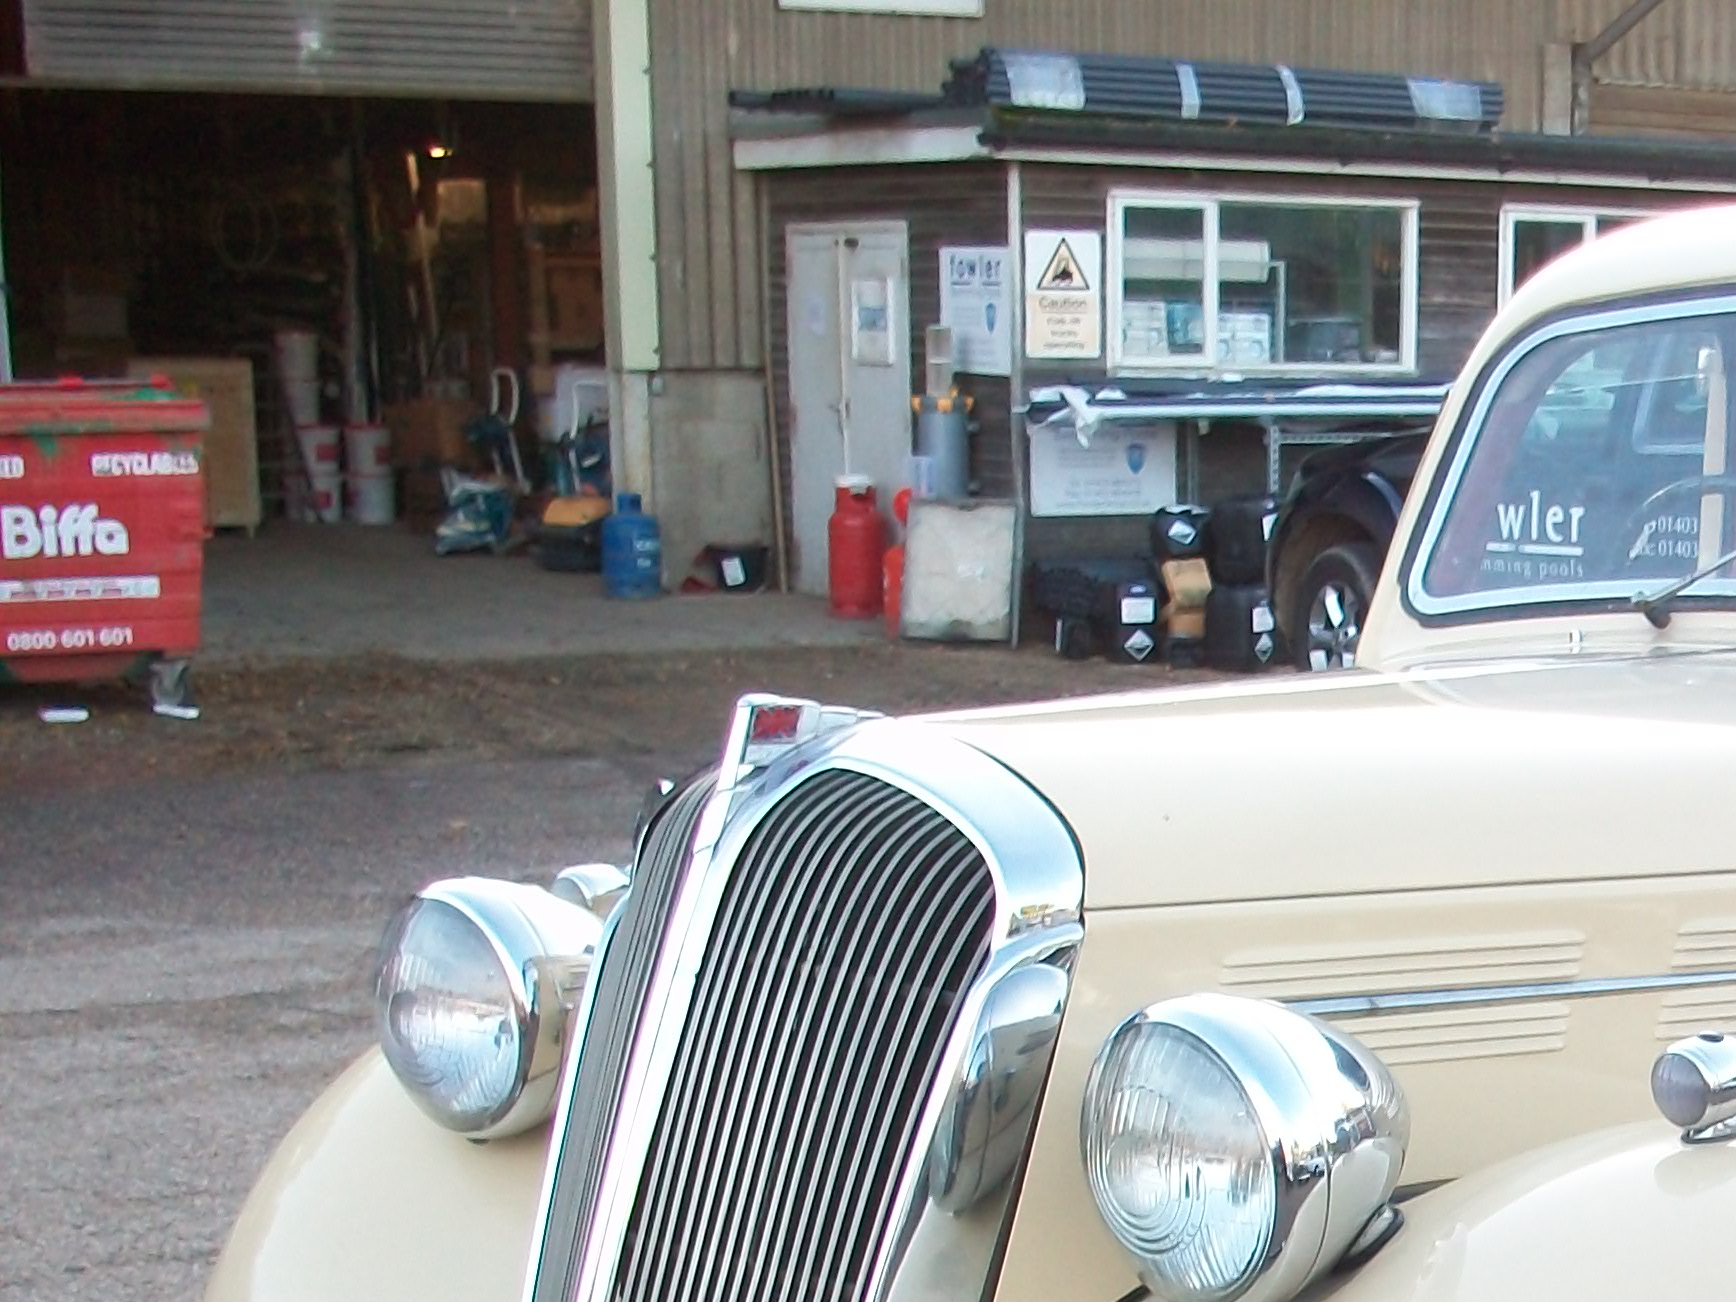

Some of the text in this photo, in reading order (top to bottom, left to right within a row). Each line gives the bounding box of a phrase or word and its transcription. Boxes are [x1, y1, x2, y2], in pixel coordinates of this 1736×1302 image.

[1, 503, 129, 559] Biffa
[1497, 490, 1586, 543] wler
[1539, 559, 1584, 581] pools
[7, 627, 133, 651] 0800 601 601
